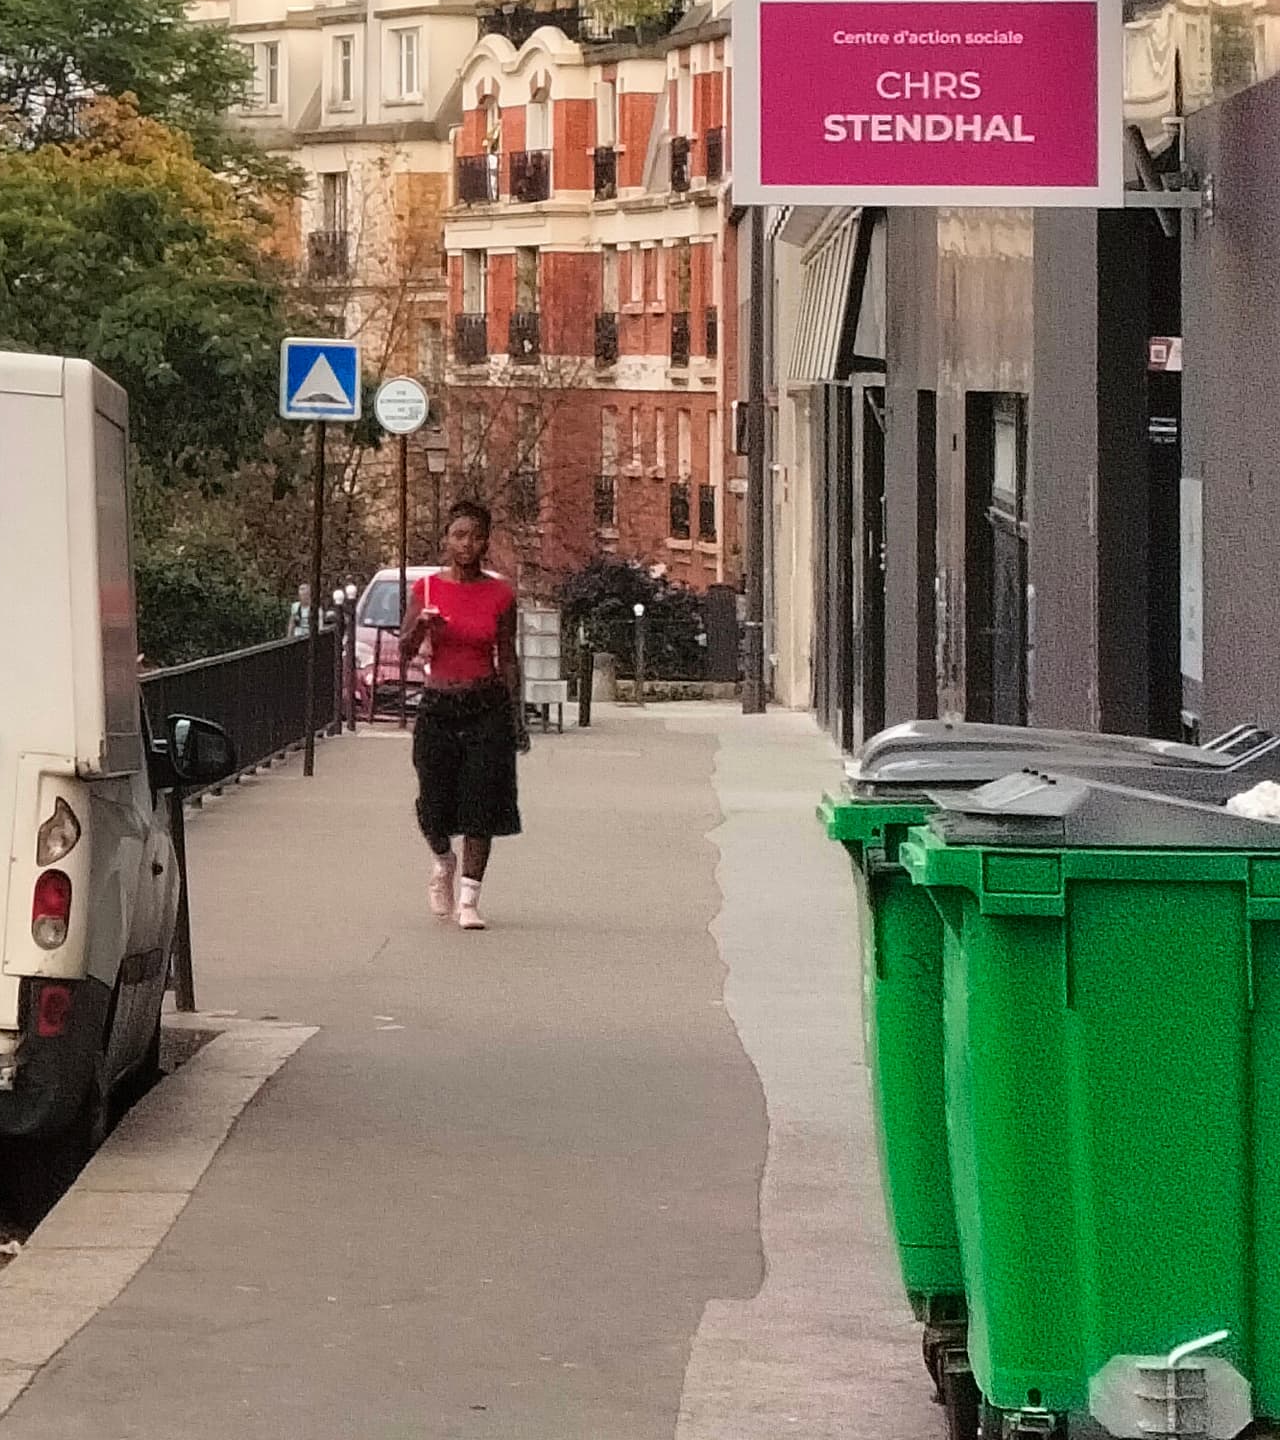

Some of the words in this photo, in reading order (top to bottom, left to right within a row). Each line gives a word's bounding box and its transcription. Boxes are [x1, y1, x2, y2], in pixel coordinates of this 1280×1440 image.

[833, 30, 890, 45] Centre
[893, 30, 961, 45] d'action
[965, 30, 1024, 45] sociale
[876, 71, 982, 100] CHRS
[824, 114, 1036, 142] STENDHAL
